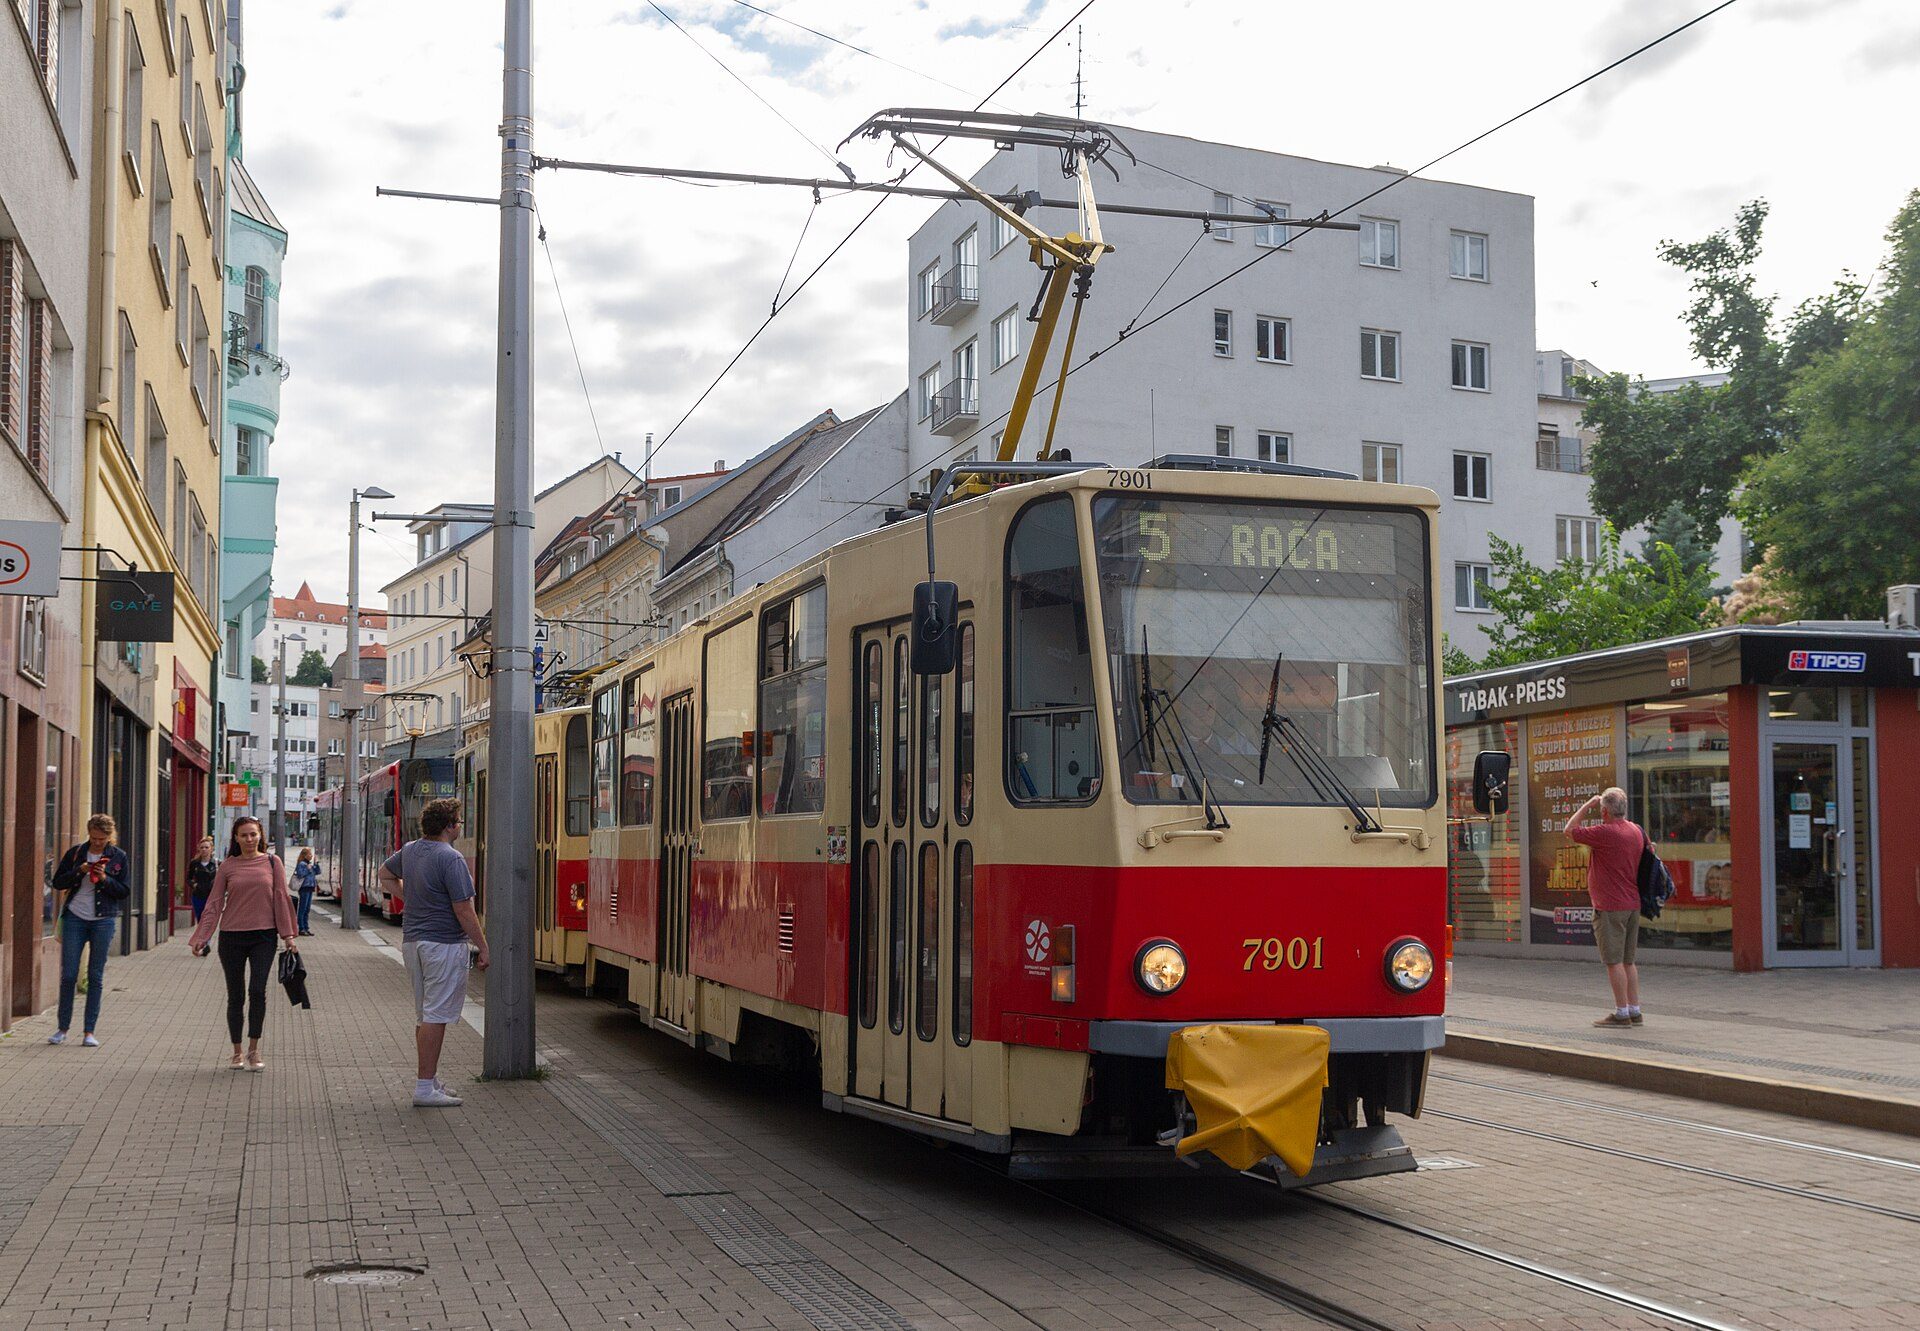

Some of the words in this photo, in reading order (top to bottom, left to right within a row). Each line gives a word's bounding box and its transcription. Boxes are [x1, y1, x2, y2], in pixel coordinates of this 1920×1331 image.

[1107, 470, 1153, 489] 7901
[1139, 512, 1170, 561] 5
[1231, 519, 1338, 571] RAČA
[0, 558, 16, 573] s
[110, 600, 163, 612] GATE
[1810, 654, 1861, 669] TIPOS
[1670, 677, 1686, 687] GGT
[1459, 685, 1509, 713] TABAK
[1516, 676, 1566, 705] PRESS
[1569, 738, 1581, 751] DO
[421, 783, 430, 793] 8
[1544, 785, 1566, 799] Hrajte
[1573, 783, 1600, 798] jackpot
[1542, 819, 1552, 832] 90
[1463, 831, 1487, 845] GGT
[1546, 869, 1588, 889] JACKPO
[1243, 936, 1323, 971] 7901
